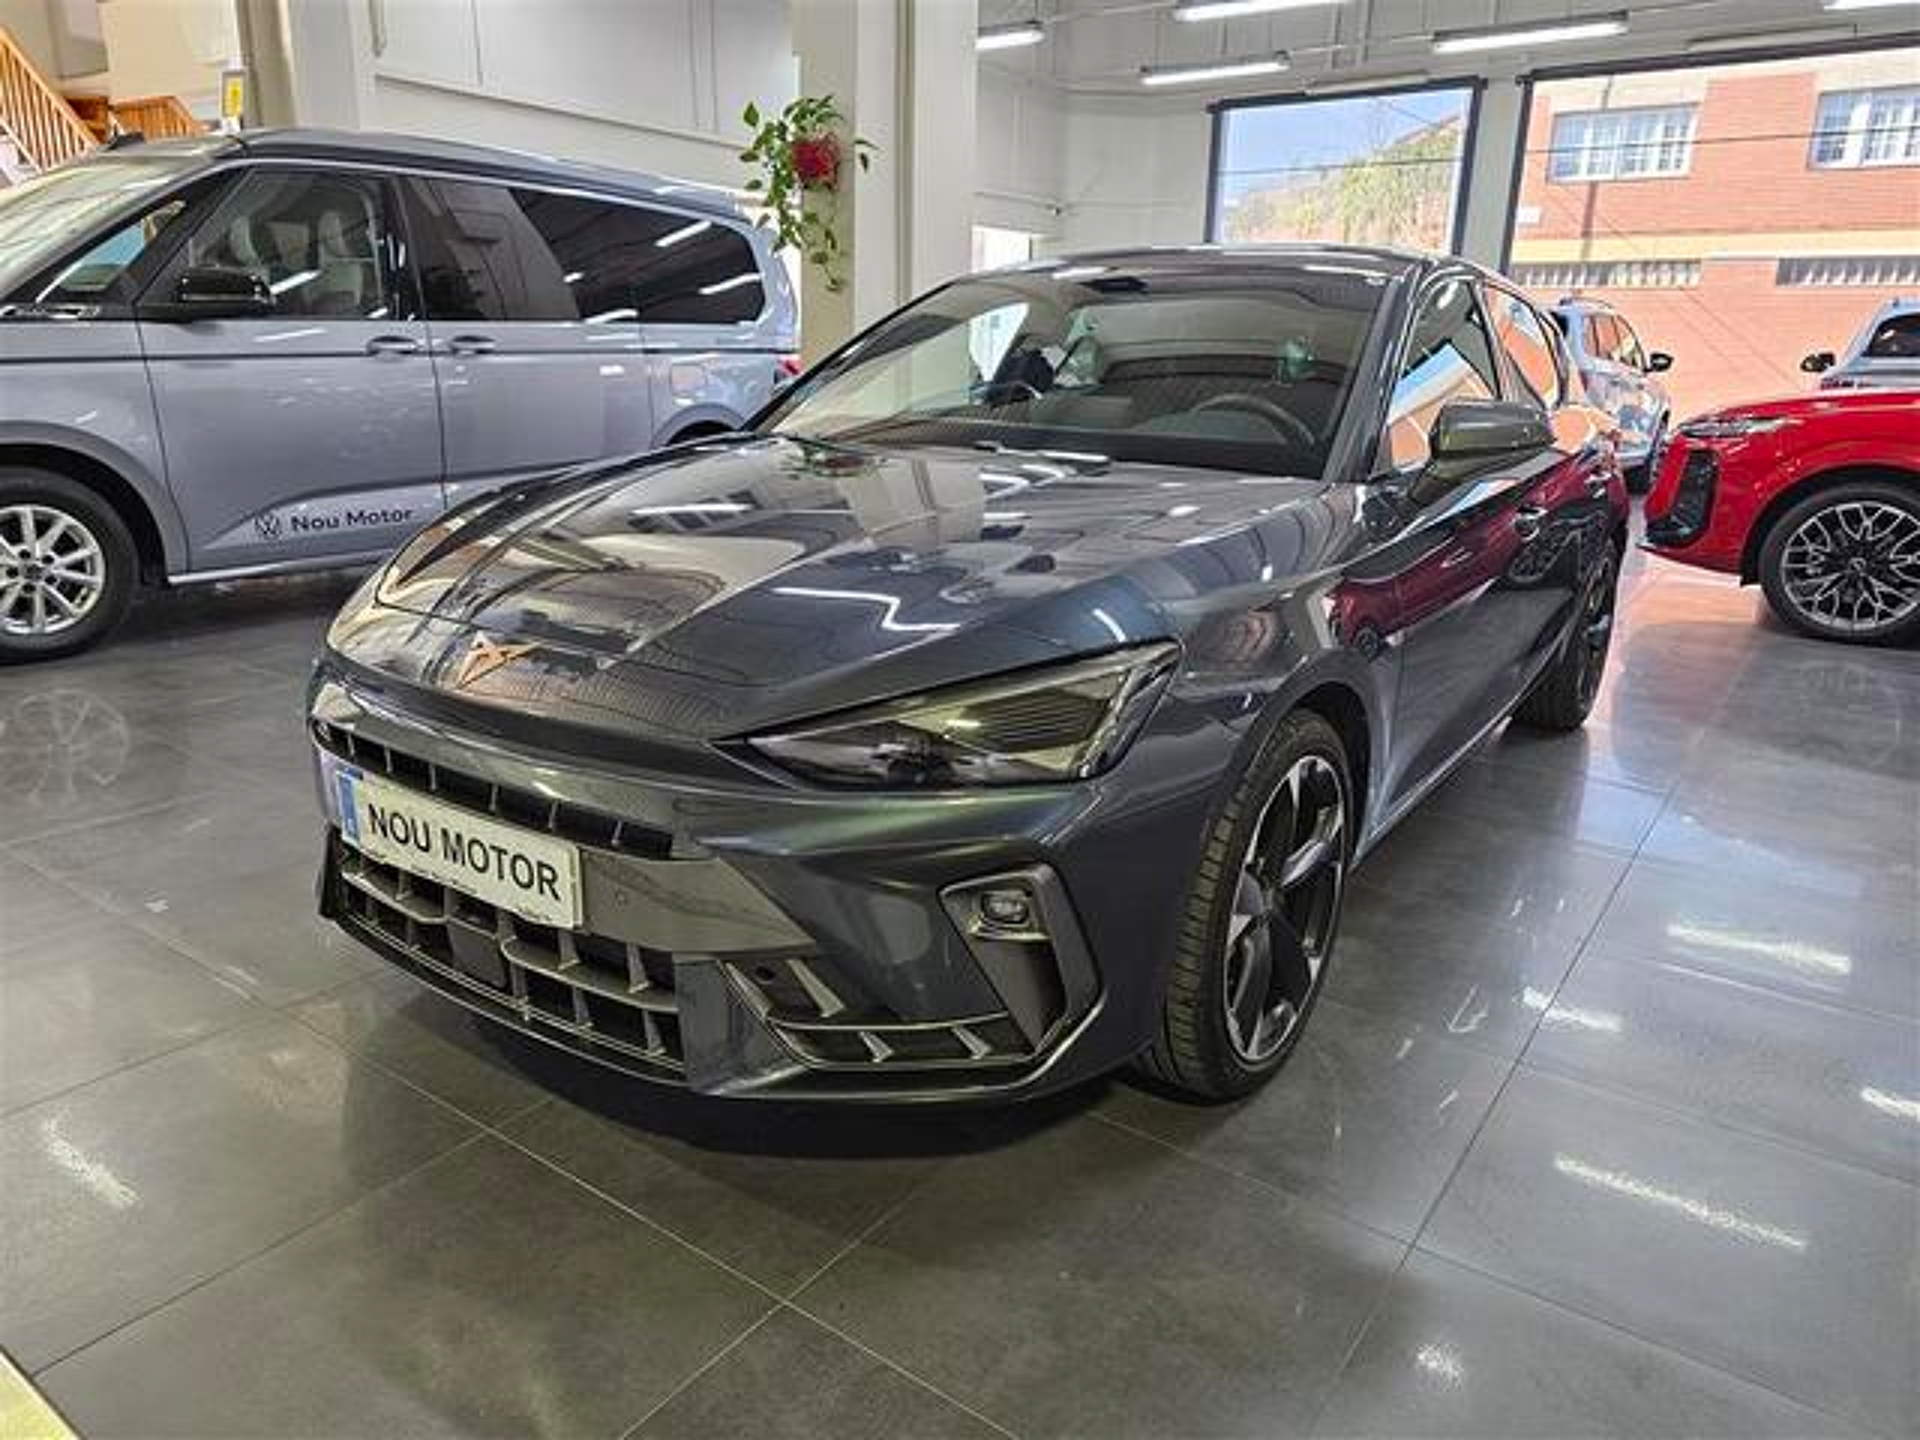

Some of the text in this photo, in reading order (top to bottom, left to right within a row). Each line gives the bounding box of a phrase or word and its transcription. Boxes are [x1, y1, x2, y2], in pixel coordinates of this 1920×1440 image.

[291, 515, 340, 532] Nou
[346, 509, 413, 527] Motor
[368, 803, 561, 901] NOU MOTOR
